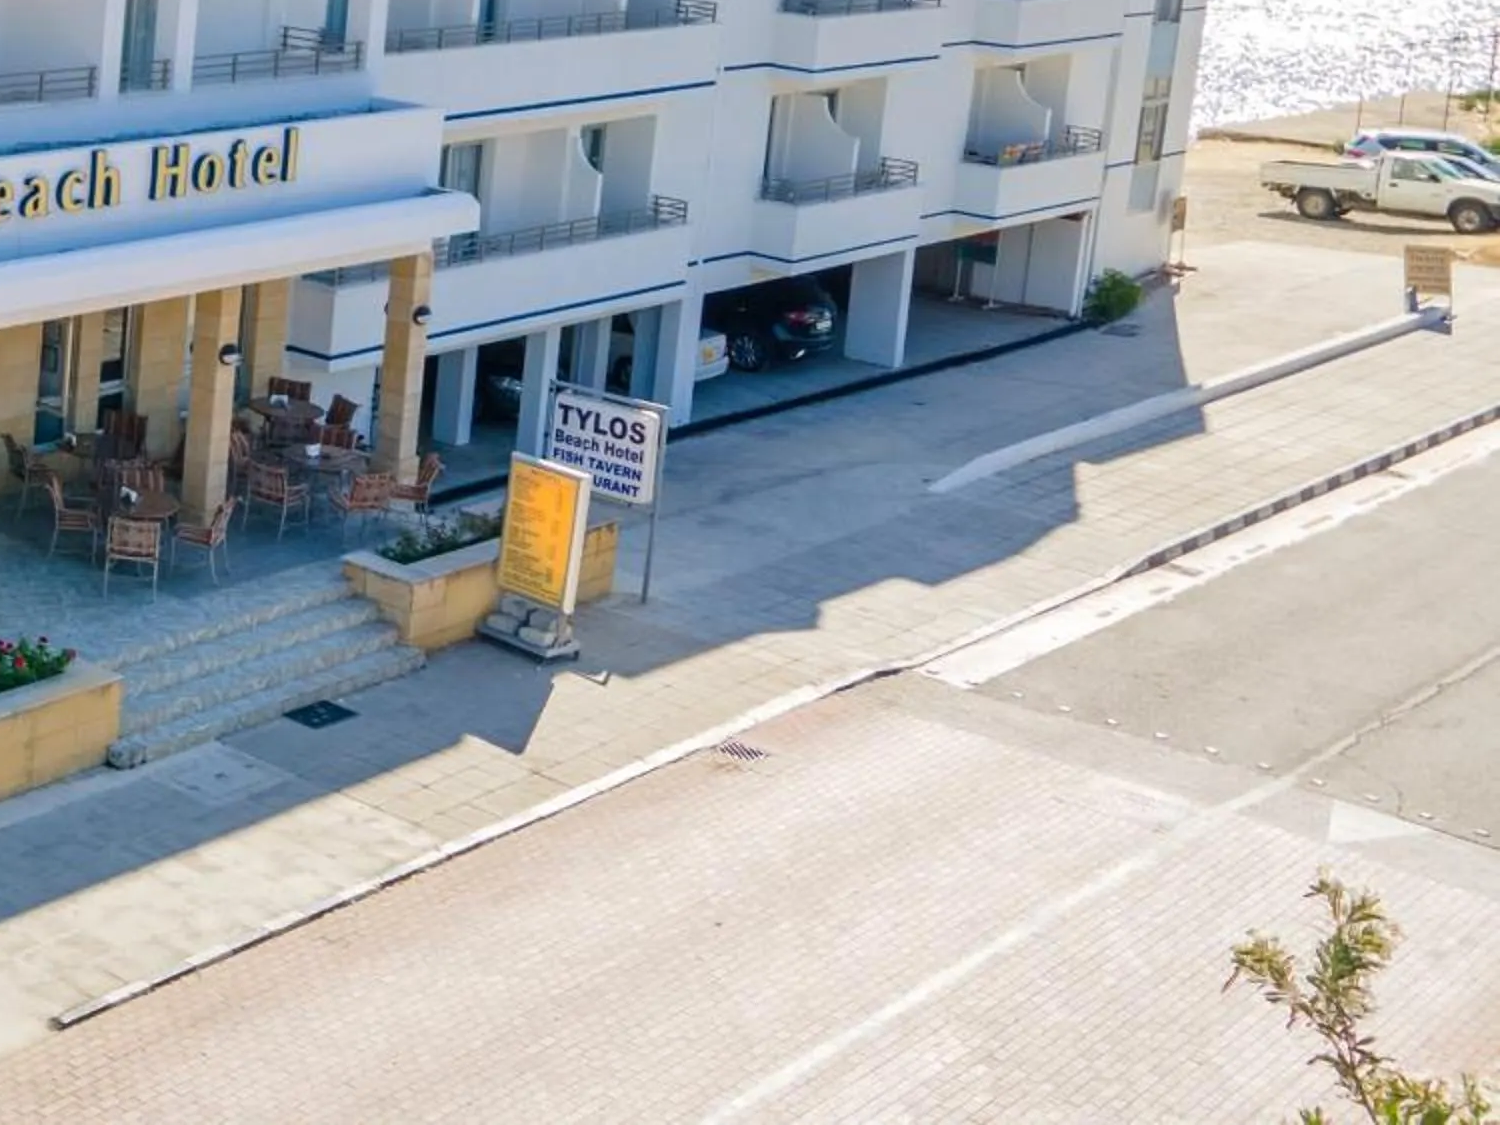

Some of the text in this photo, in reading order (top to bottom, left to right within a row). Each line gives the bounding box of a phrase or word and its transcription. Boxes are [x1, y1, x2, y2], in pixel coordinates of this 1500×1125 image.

[149, 126, 300, 202] Hotel
[558, 403, 646, 445] TYLOS
[555, 428, 645, 464] Beach Hotel
[553, 447, 584, 466] FISH
[588, 457, 642, 482] TAVERN
[593, 475, 640, 497] URANT
